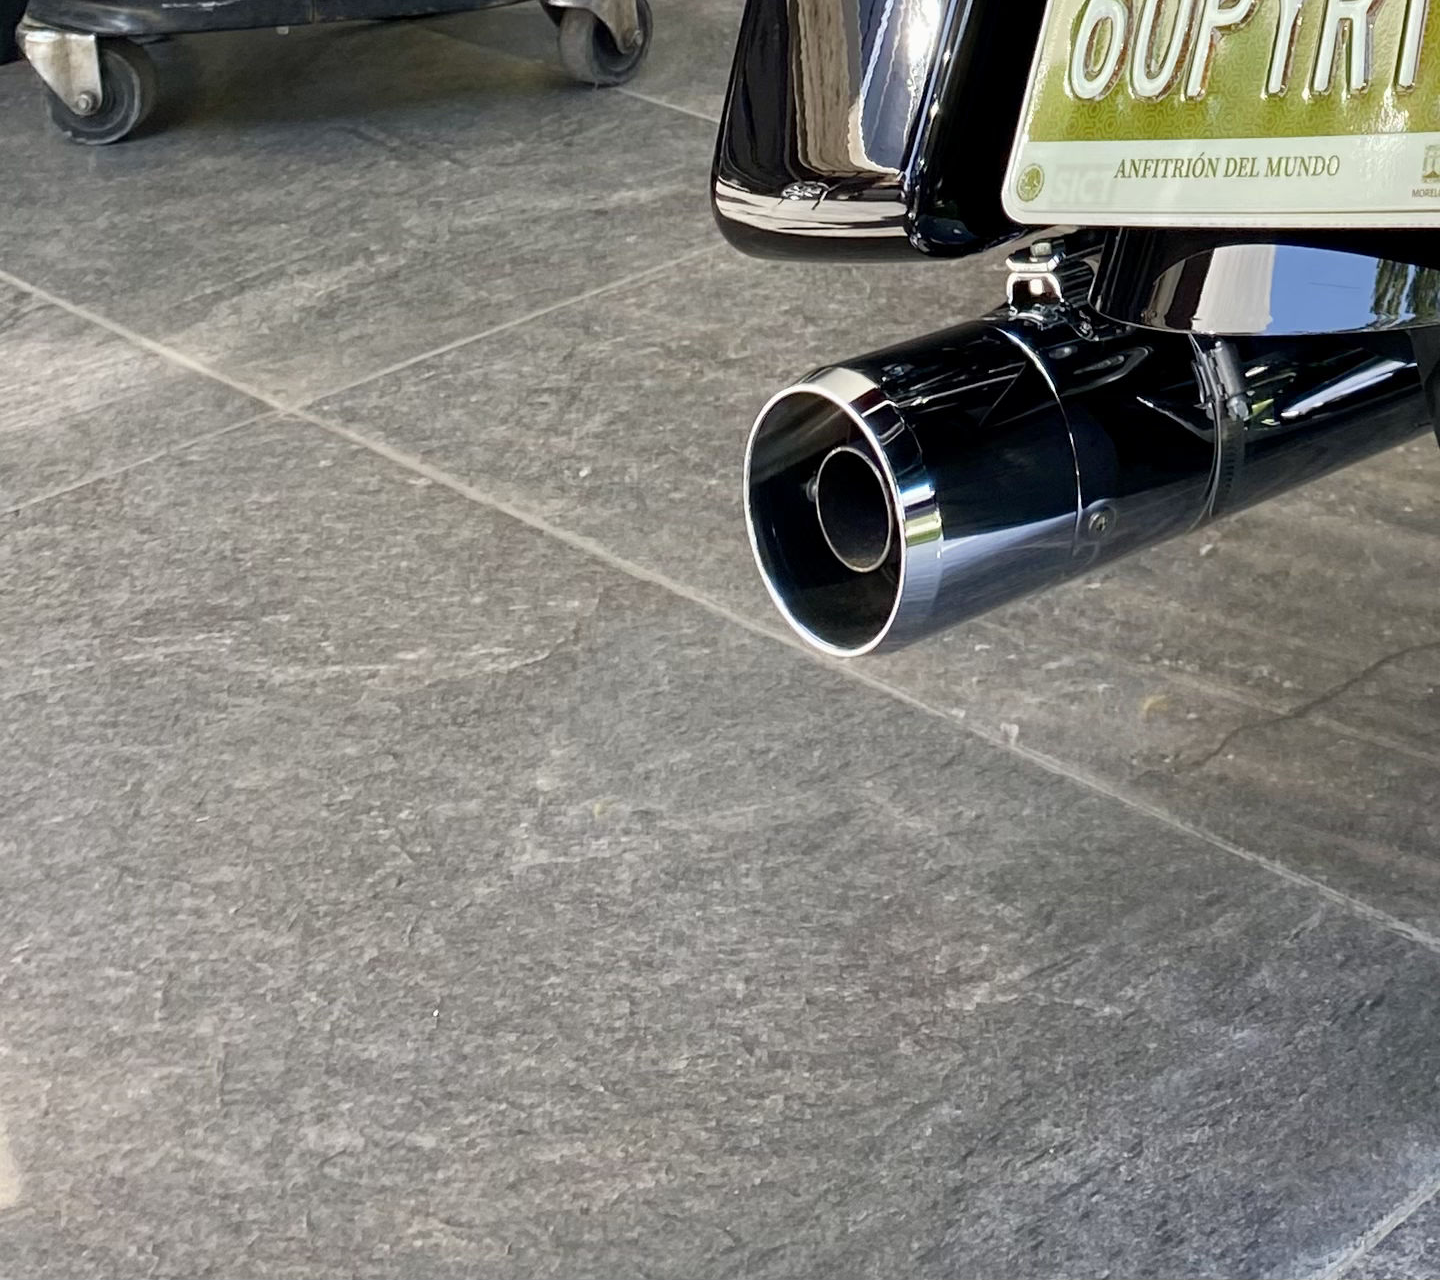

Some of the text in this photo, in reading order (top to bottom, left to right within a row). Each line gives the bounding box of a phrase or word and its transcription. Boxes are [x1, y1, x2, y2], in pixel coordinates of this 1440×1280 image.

[1113, 152, 1341, 179] ANFITRIÓN DEL MUNDO
